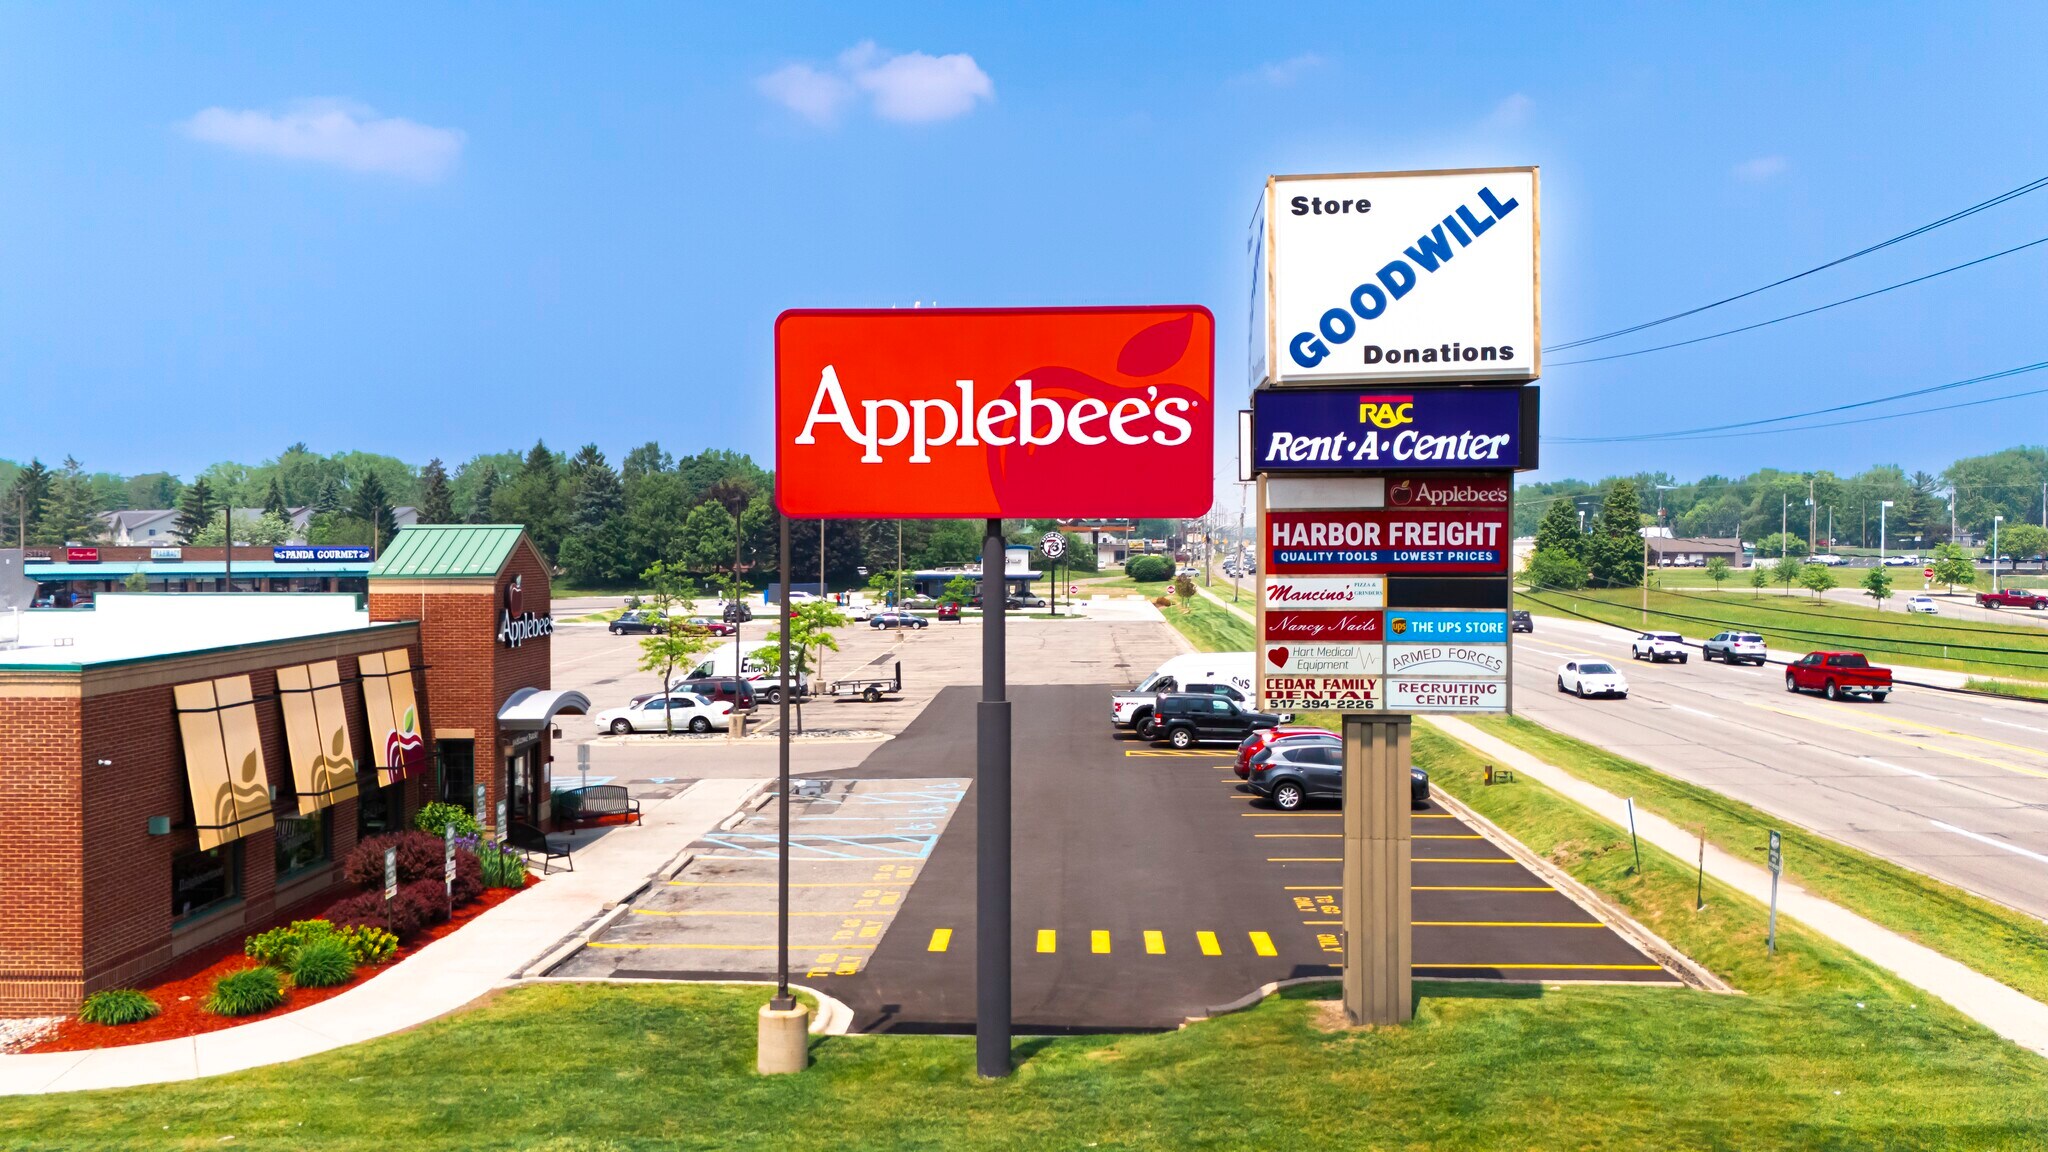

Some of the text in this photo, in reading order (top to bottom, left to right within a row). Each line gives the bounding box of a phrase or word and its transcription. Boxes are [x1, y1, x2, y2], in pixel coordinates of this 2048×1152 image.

[1290, 196, 1372, 216] Store
[1289, 186, 1520, 368] GOODWILL
[1363, 342, 1514, 365] Donations
[794, 364, 1193, 464] Applebee's
[1359, 402, 1414, 429] RAC
[1415, 482, 1508, 506] Applebee's
[1272, 521, 1502, 547] HARBOR FREIGHT
[285, 550, 359, 559] PANDA GOURMET
[1280, 551, 1493, 562] QUALITY TOOLS LOWEST PRICES
[1266, 584, 1355, 602] Mancino's
[1269, 615, 1377, 636] Nancy Nails
[1392, 623, 1407, 634] ups
[1411, 621, 1504, 633] THE UPS STORE
[1292, 646, 1354, 657] Hart Medical
[1297, 659, 1349, 671] Equipment
[1392, 647, 1503, 671] ARMED FORCES
[1266, 678, 1378, 690] CEDAR FAMILY
[1398, 683, 1498, 695] RECRUITING
[1265, 690, 1380, 700] DENTAL
[1415, 695, 1480, 706] CENTER
[1270, 699, 1375, 709] 517-394-2226
